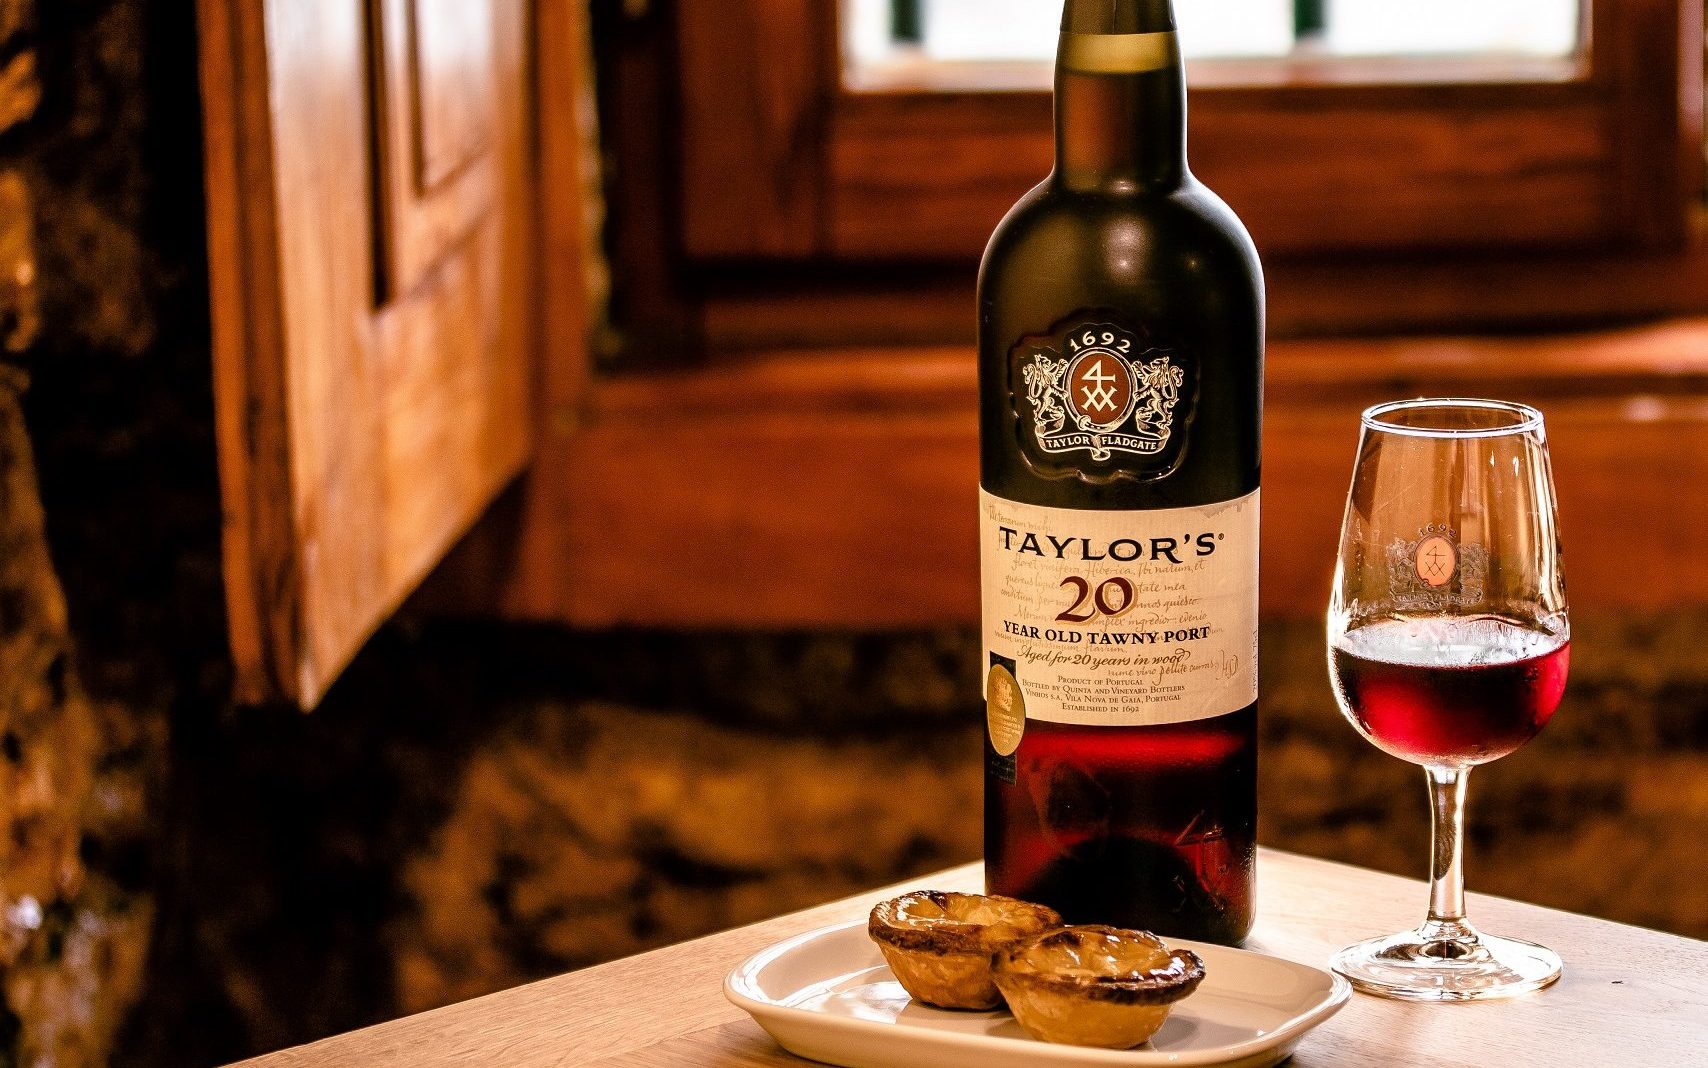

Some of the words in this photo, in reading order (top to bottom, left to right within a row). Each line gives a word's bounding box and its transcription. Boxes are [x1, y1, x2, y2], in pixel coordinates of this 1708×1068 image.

[1070, 331, 1131, 353] 1692
[1046, 436, 1090, 448] TAYLOR
[1101, 436, 1157, 450] FLADGATE
[1418, 522, 1457, 538] 1692
[1055, 575, 1136, 624] 20
[1003, 620, 1041, 640] YEAR
[1044, 628, 1083, 644] OLD
[1087, 631, 1160, 645] TAWNY
[1163, 626, 1211, 643] PORT
[1016, 645, 1052, 665] Aged
[1048, 651, 1073, 667] for
[1071, 654, 1091, 665] 20
[1089, 656, 1131, 670] years
[1133, 654, 1150, 666] in
[1152, 648, 1191, 666] wood
[1022, 679, 1050, 690] BOTTLED
[1052, 684, 1060, 692] BY
[1062, 684, 1092, 695] QUINTA
[1111, 687, 1148, 695] VINEYARD
[1150, 685, 1186, 694] BOTTLERS
[1057, 675, 1092, 686] PRODUCT
[1106, 678, 1143, 686] PORTUGAL
[1065, 694, 1082, 702] VILA
[1084, 695, 1106, 704] NOVA
[1121, 696, 1144, 704] GAIA,
[1145, 694, 1181, 703] PORTUGAL
[1062, 702, 1108, 713] ESTABLISHED
